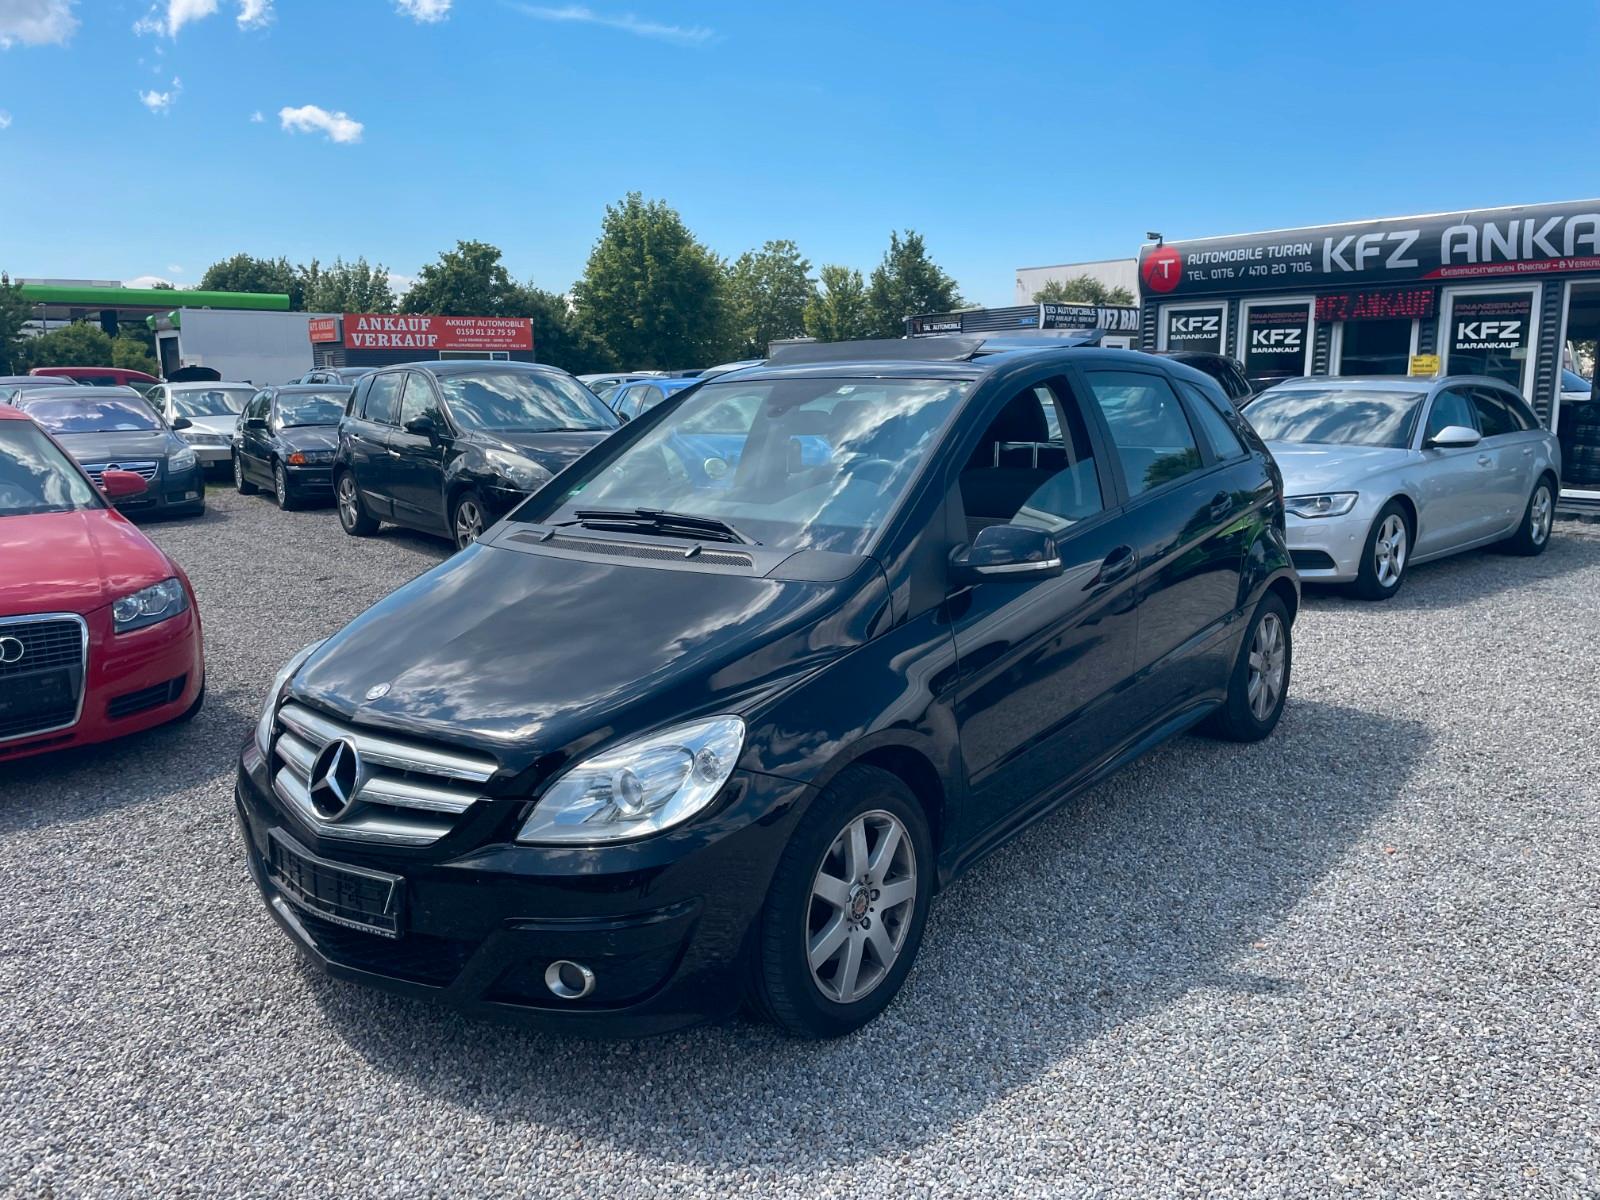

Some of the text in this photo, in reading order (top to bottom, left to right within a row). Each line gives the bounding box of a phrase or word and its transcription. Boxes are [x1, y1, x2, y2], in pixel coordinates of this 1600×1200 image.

[1322, 213, 1600, 273] KFZ ANKA
[1187, 242, 1313, 266] AUTOMOBILE TURAN
[1187, 269, 1208, 281] TEL.
[1211, 267, 1235, 279] 0176
[1249, 264, 1268, 275] 470
[1271, 263, 1287, 274] 20
[1290, 261, 1313, 273] 706
[1517, 262, 1551, 272] ANKAUF
[356, 317, 431, 331] ANKAUF
[445, 319, 525, 328] AKKURT AUTOMOBILE
[1171, 316, 1219, 332] KFZ
[1457, 321, 1521, 340] KFZ
[456, 328, 475, 336] 0159
[475, 328, 485, 336] 01
[1252, 329, 1302, 345] KFZ
[351, 333, 438, 347] VERKAUF
[1456, 341, 1520, 350] BARANKAUF
[1251, 346, 1300, 354] BARANKAUF
